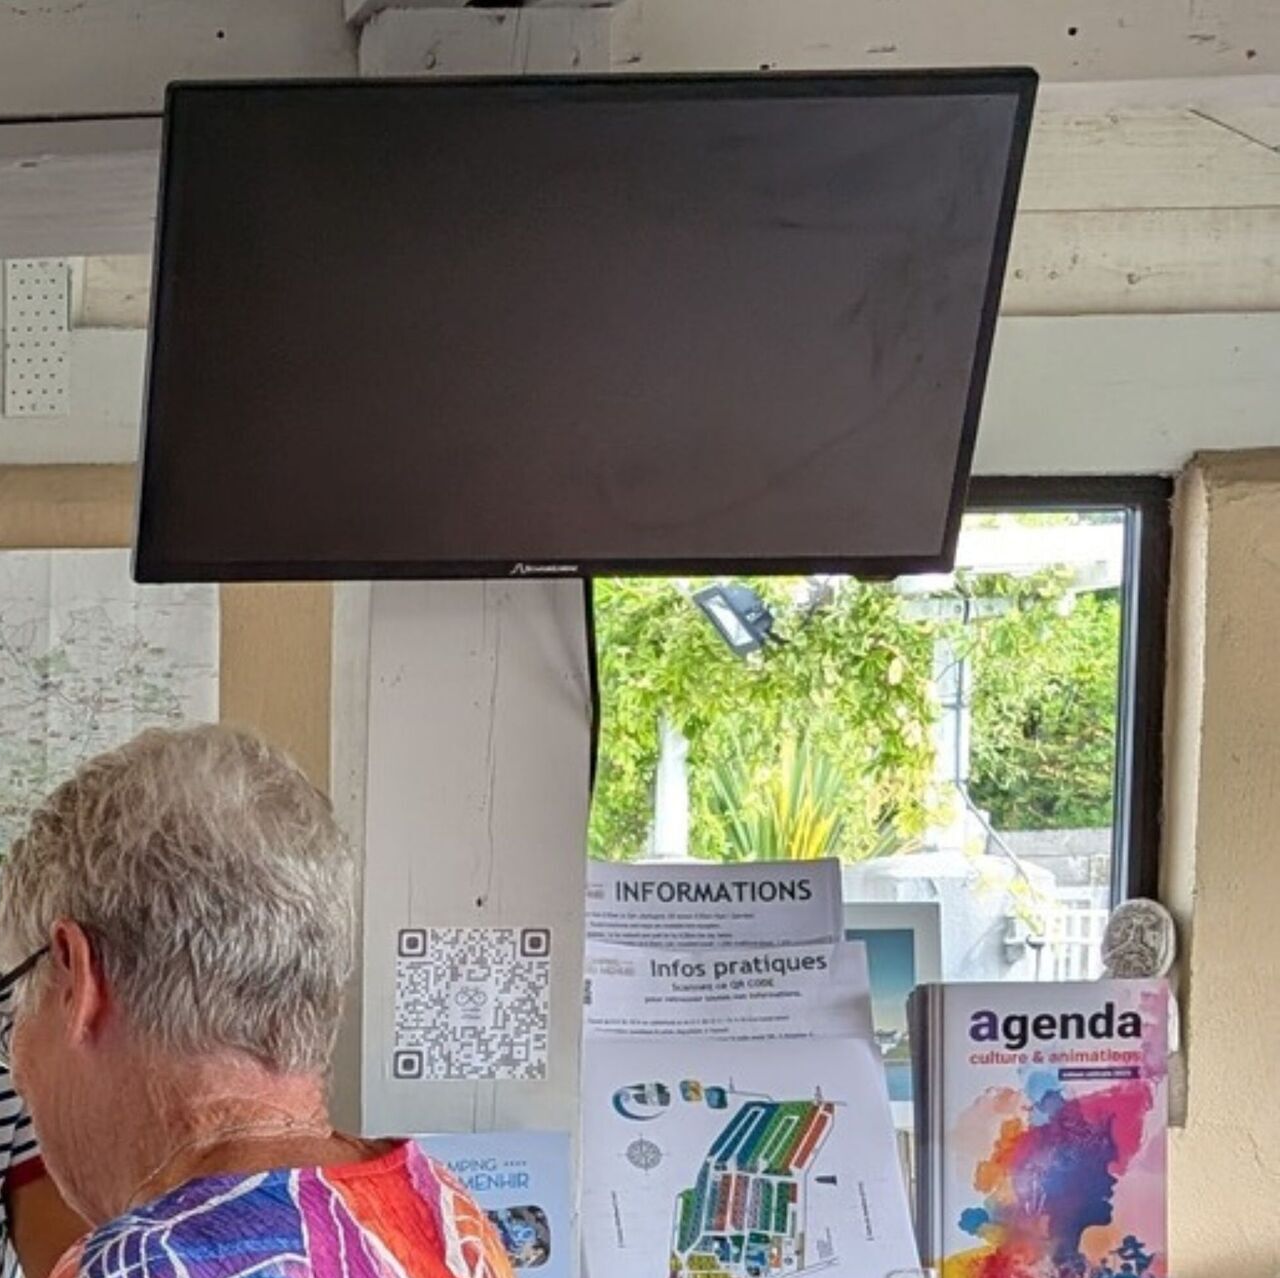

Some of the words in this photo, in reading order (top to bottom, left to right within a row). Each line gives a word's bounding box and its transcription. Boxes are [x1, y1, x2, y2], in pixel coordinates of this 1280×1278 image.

[615, 879, 813, 903] INFORMATIONS
[650, 958, 707, 978] Infos
[713, 953, 828, 980] pratiques
[729, 979, 745, 990] QR
[747, 978, 774, 989] CODE
[969, 1001, 1143, 1051] agenda
[969, 1050, 1028, 1065] culture
[1032, 1051, 1044, 1064] &
[1048, 1049, 1144, 1064] animations
